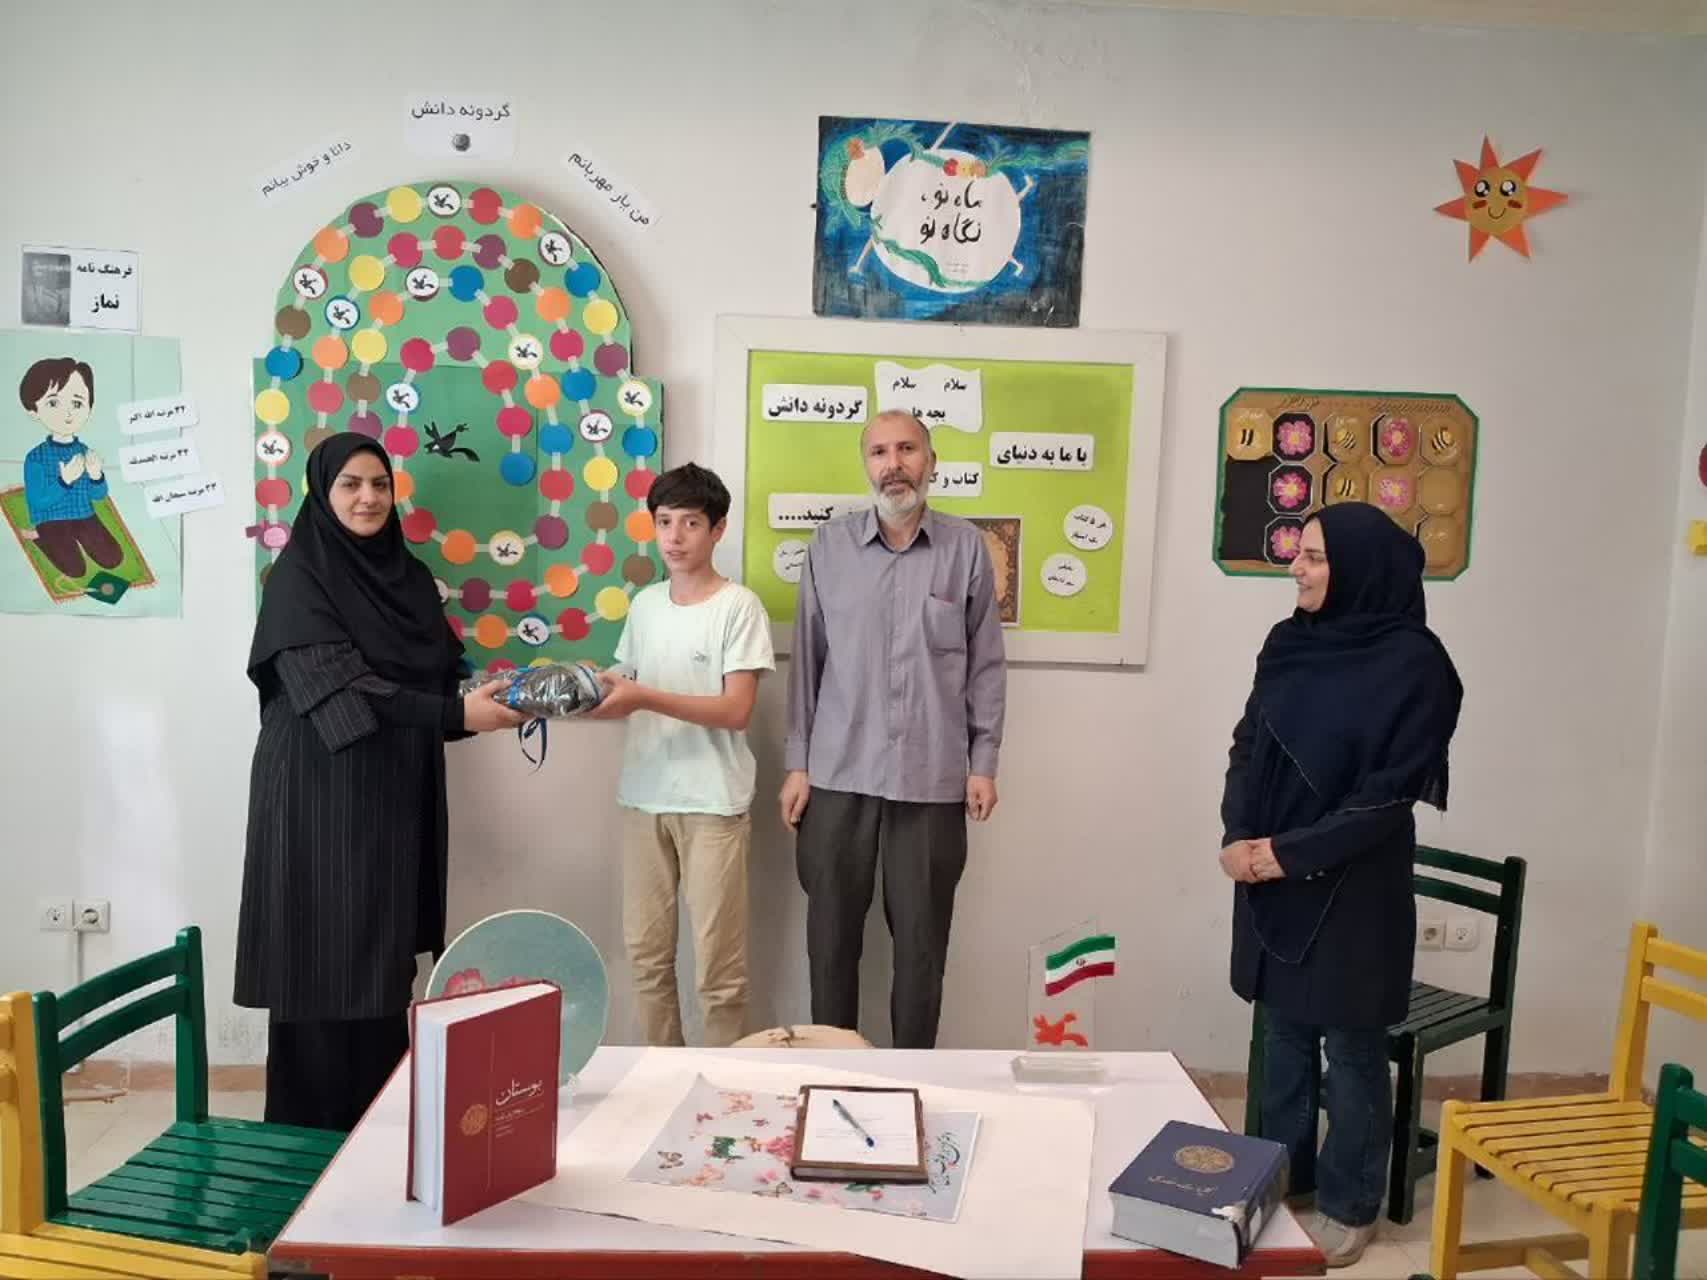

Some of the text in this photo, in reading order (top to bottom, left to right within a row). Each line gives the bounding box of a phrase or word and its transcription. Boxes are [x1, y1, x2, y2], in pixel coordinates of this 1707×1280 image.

[411, 101, 510, 121] گردونه دانش
[323, 153, 331, 165] و
[329, 142, 352, 157] دانا
[291, 156, 320, 181] خوش
[568, 153, 649, 224] من یار مهربانم
[953, 179, 982, 209] ماه
[919, 212, 982, 245] نگاه نو
[91, 293, 120, 313] نماز
[892, 376, 968, 392] سلام سلام
[768, 395, 863, 419] گردونه دانش
[926, 407, 946, 421] بچه
[997, 444, 1088, 467] با ما به دنیای
[942, 475, 950, 489] و
[952, 471, 980, 487] کتاب
[495, 1078, 545, 1107] بوستان
